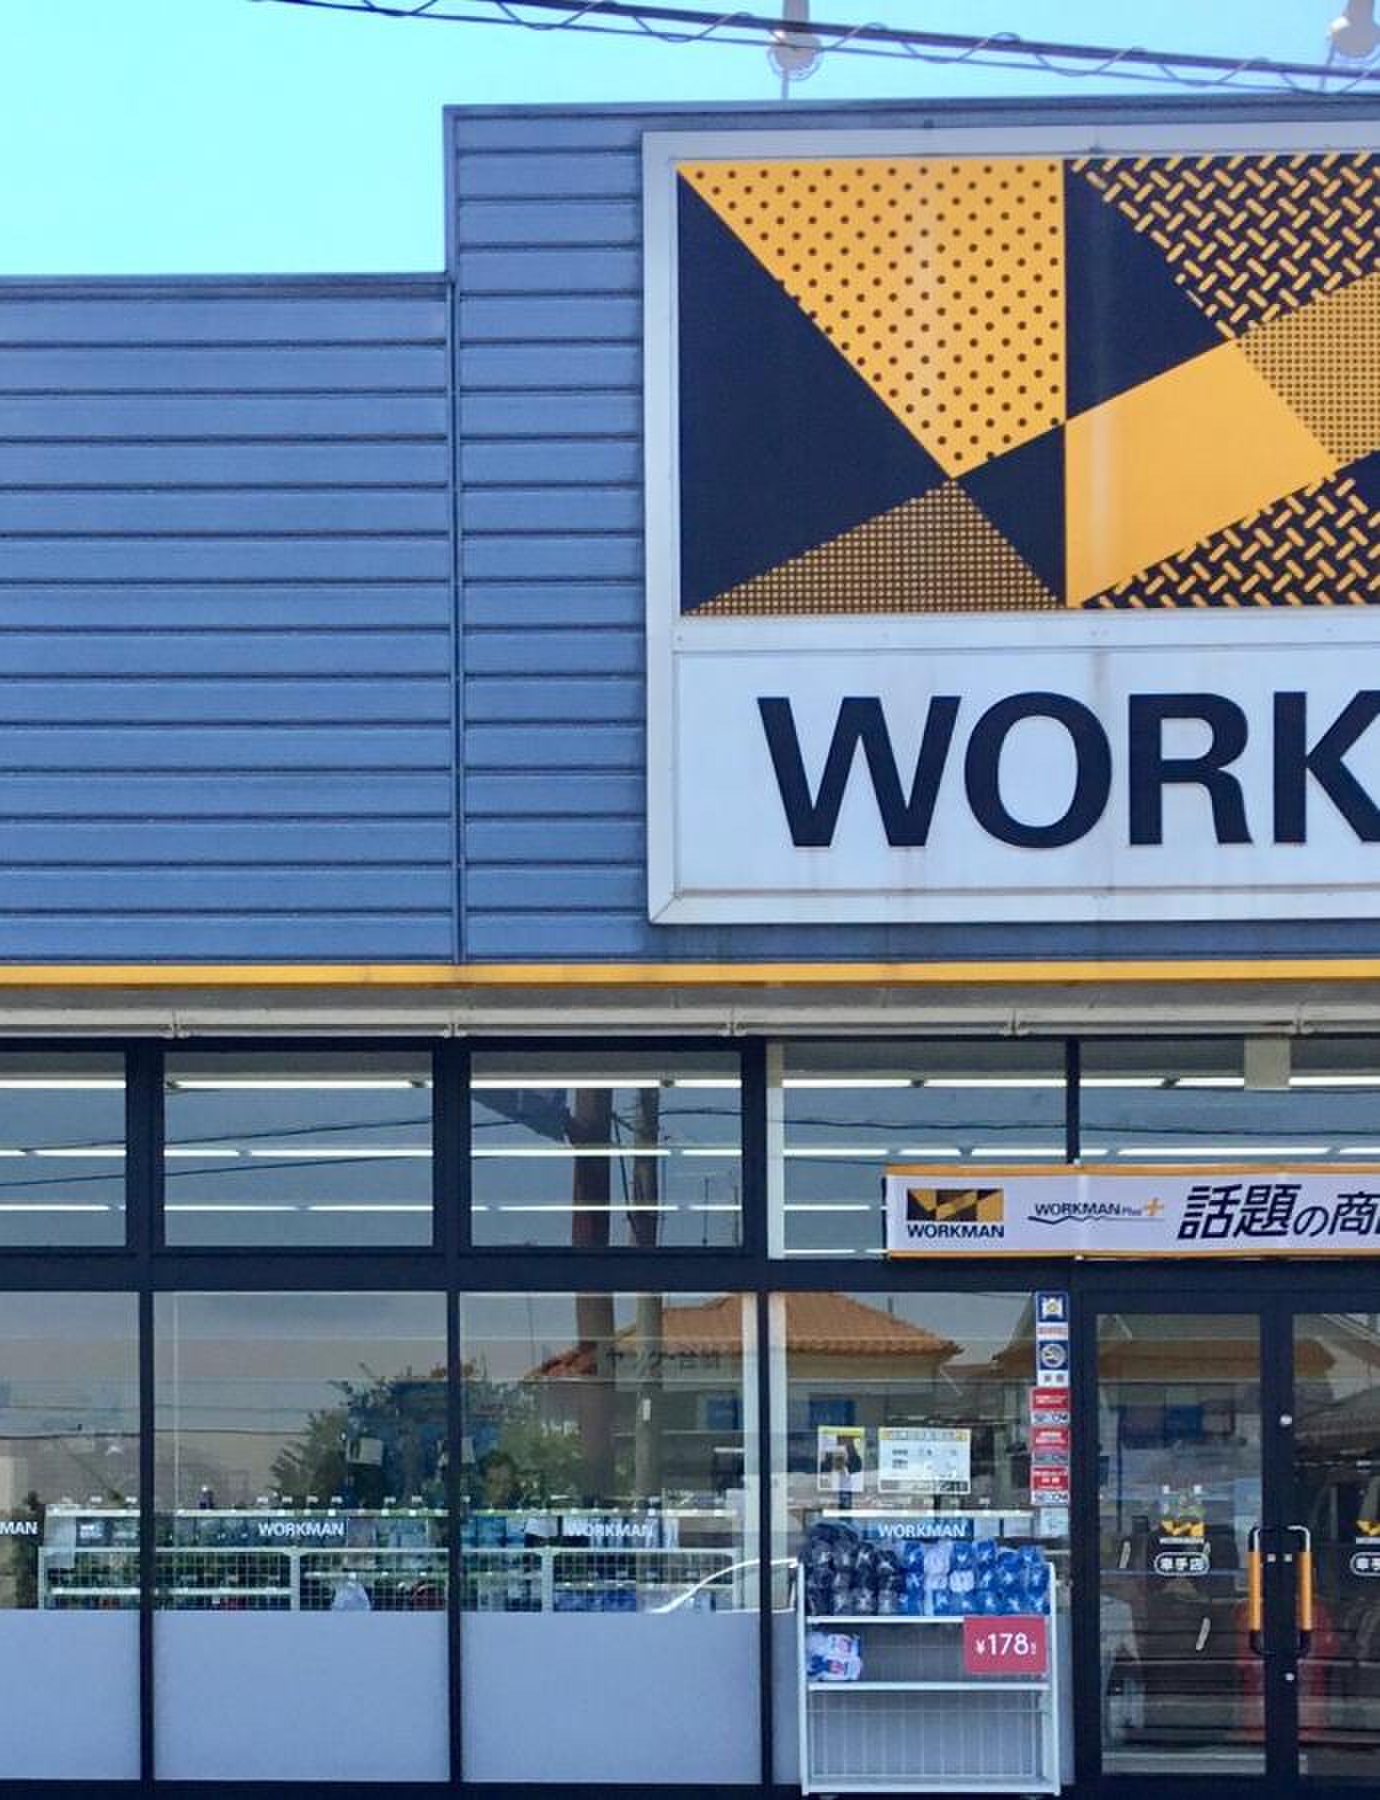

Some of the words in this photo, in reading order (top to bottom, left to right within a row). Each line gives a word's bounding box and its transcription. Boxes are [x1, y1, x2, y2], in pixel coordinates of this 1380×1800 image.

[756, 690, 1380, 849] WORK
[1035, 1202, 1120, 1215] WORKMAN
[1177, 1184, 1380, 1239] 話題の商
[906, 1224, 1005, 1239] WORKMAN
[258, 1521, 345, 1537] WORKMAN
[565, 1521, 654, 1537] WORKMAN
[877, 1523, 966, 1538] WORKMAN
[975, 1632, 1029, 1655] ¥178
